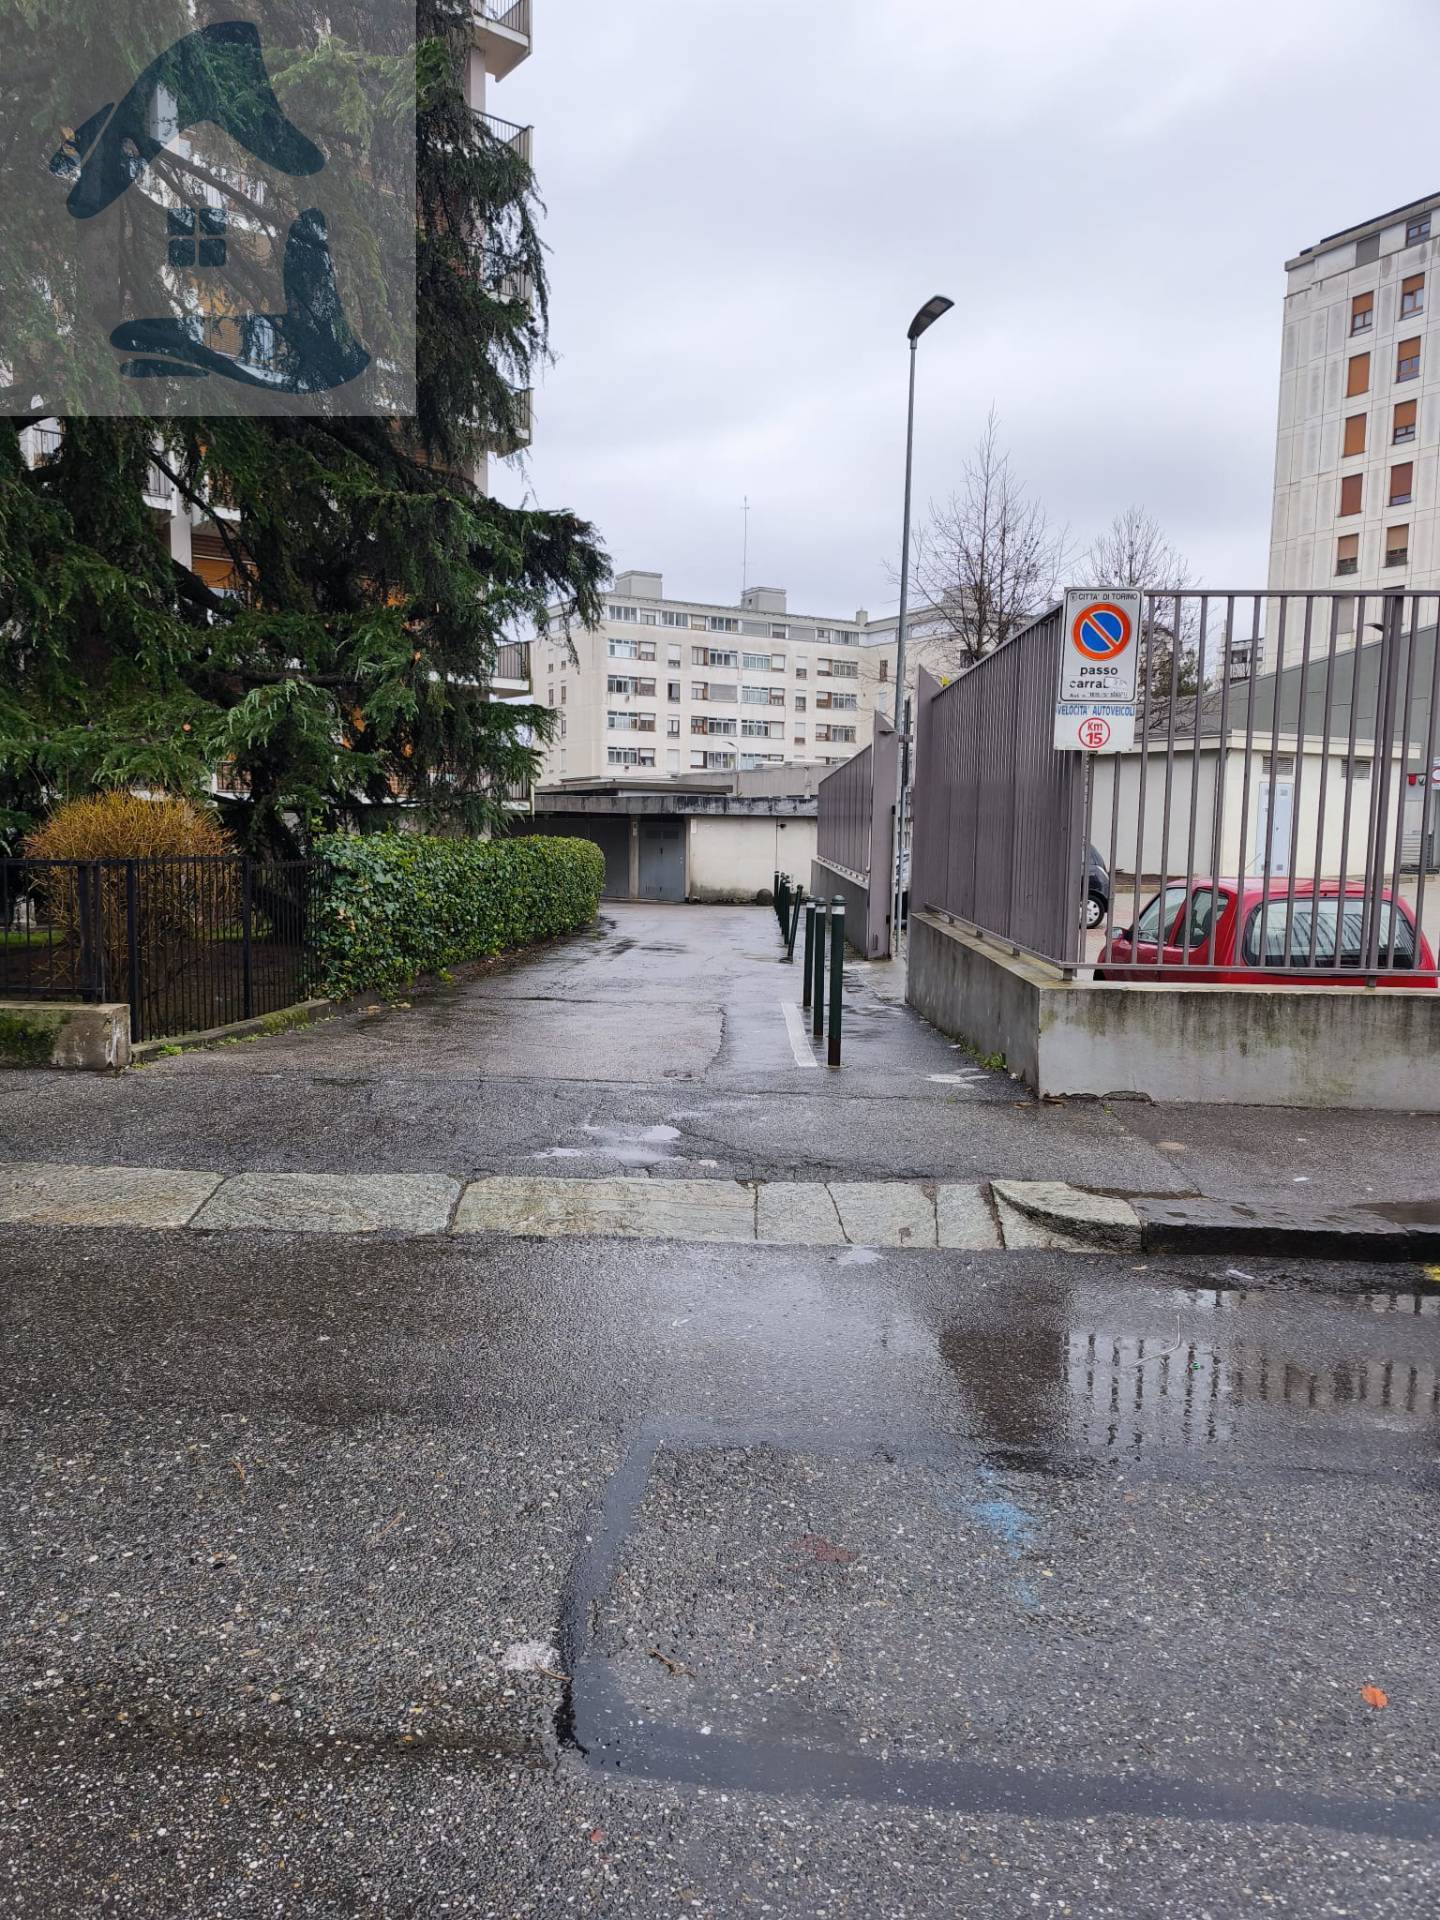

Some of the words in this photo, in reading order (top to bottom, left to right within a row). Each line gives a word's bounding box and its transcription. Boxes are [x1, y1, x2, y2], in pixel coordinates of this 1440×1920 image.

[1102, 593, 1110, 601] DI
[1111, 593, 1138, 601] TORINO
[1080, 667, 1118, 677] passo
[1092, 705, 1135, 717] AUTOVEICOLI
[1087, 722, 1103, 731] Km
[1086, 733, 1103, 744] 15
